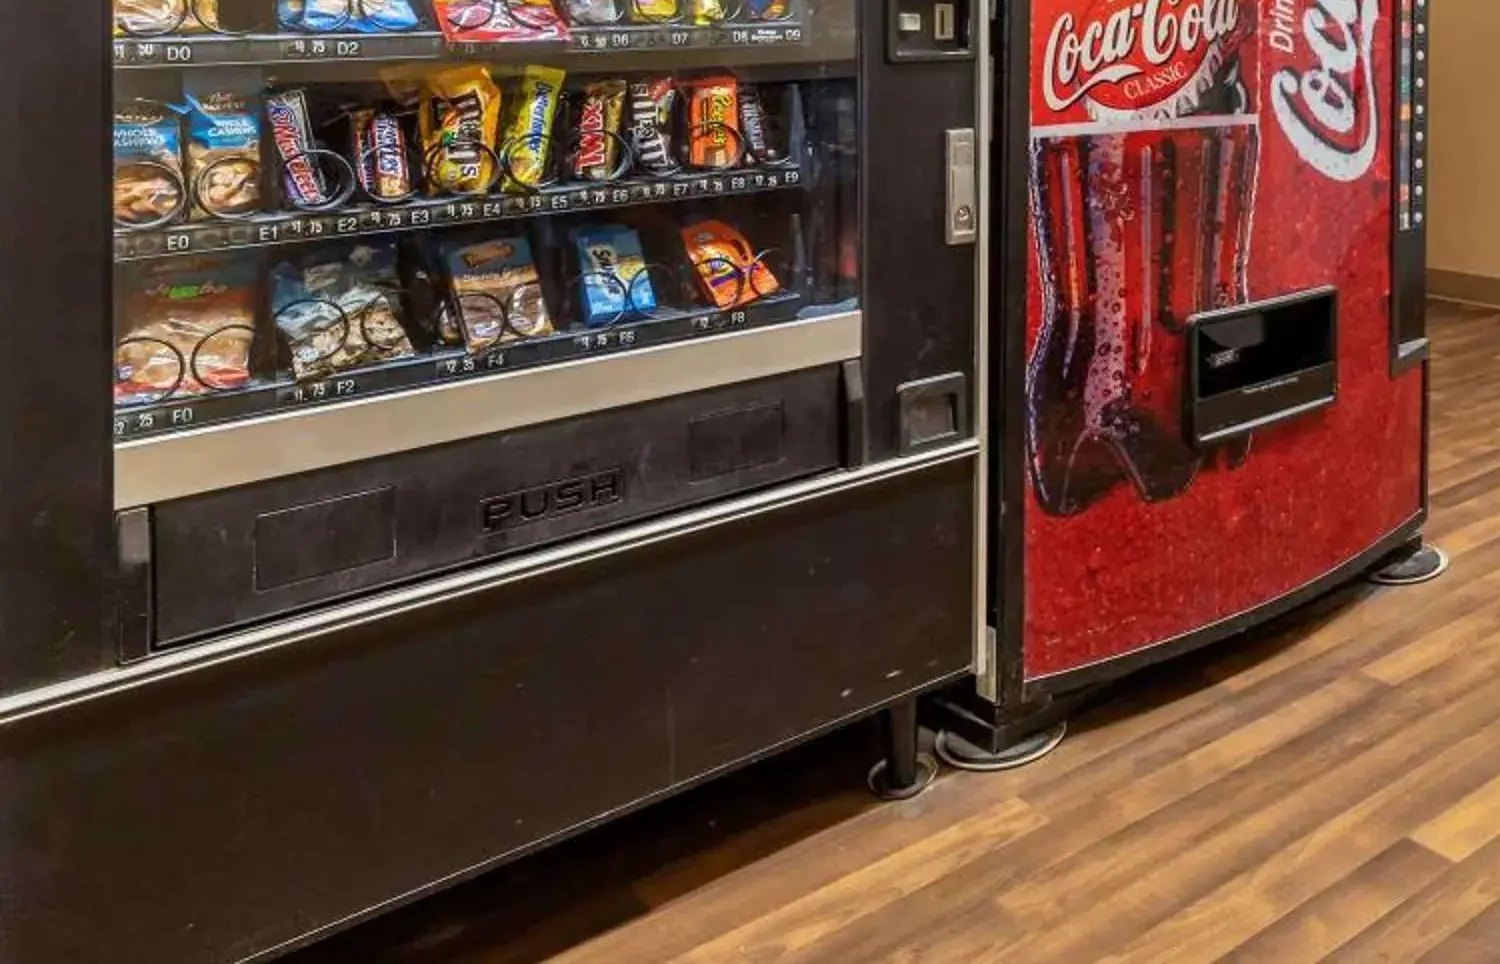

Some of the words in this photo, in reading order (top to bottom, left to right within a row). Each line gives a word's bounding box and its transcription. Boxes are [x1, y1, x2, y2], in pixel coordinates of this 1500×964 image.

[167, 45, 191, 60] D0
[337, 40, 360, 55] D2
[1123, 60, 1188, 101] CLASSIC
[551, 195, 568, 209] E5
[612, 189, 629, 203] E6
[411, 209, 429, 224] E3
[483, 203, 500, 217] E4
[337, 217, 358, 232] E2
[259, 225, 278, 241] E1
[167, 235, 190, 250] E0
[731, 311, 746, 324] F8
[337, 380, 356, 395] F2
[172, 407, 193, 423] F0
[480, 468, 623, 532] PUSH
